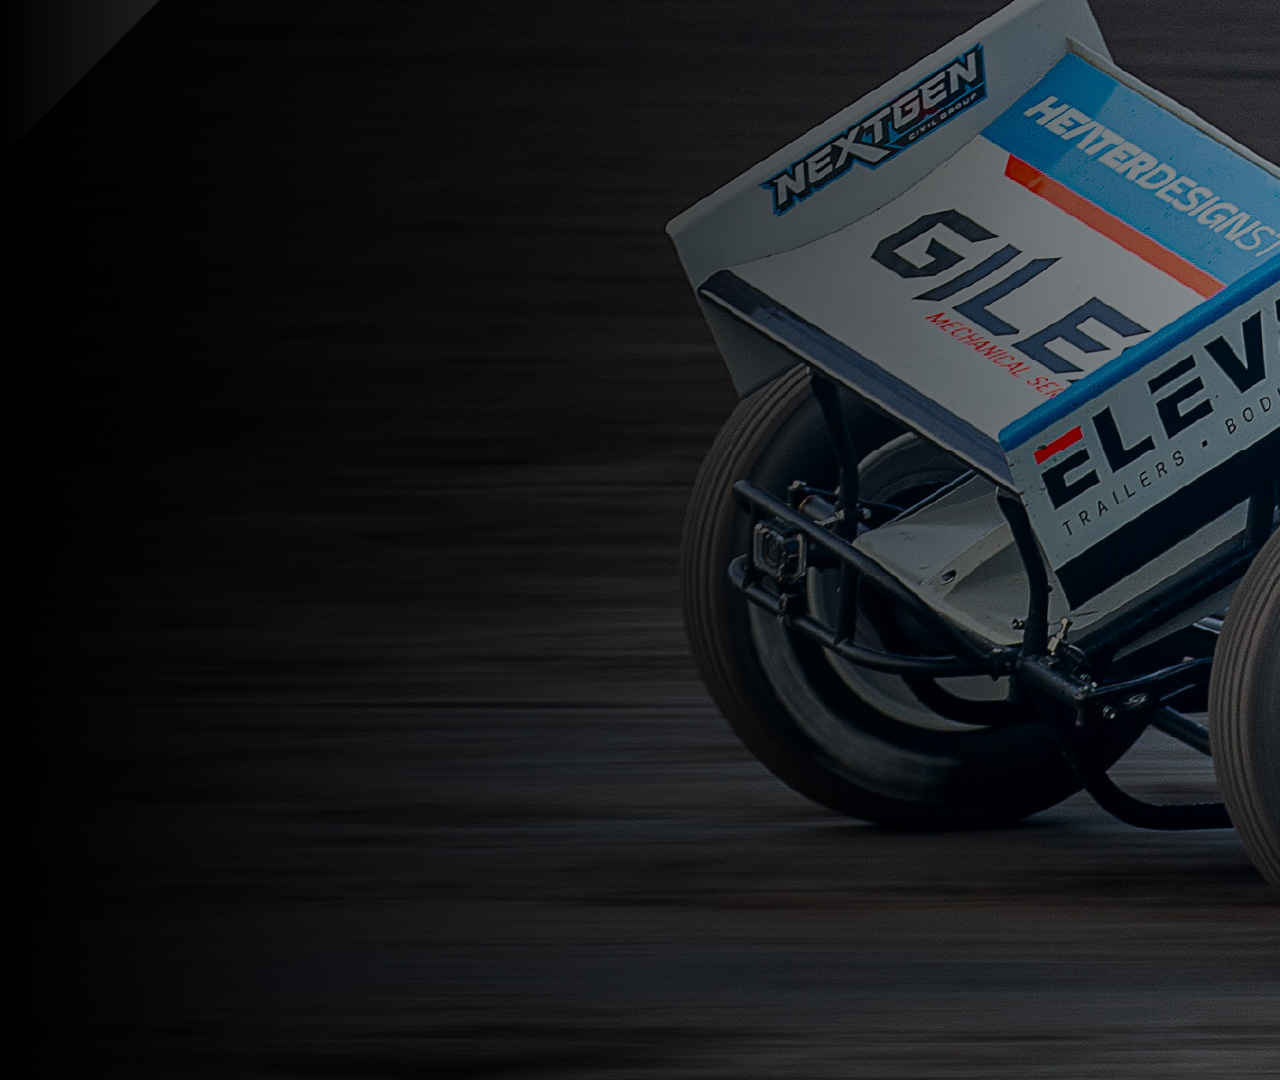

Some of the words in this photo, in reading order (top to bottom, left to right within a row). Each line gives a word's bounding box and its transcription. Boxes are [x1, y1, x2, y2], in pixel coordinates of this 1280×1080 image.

[771, 50, 981, 207] NEXTGEN
[908, 120, 937, 141] CIVIL
[940, 92, 977, 120] GROUP
[870, 208, 1152, 376] GILE
[924, 311, 1031, 379] MECHANICAL
[1062, 449, 1187, 538] TRAILERS
